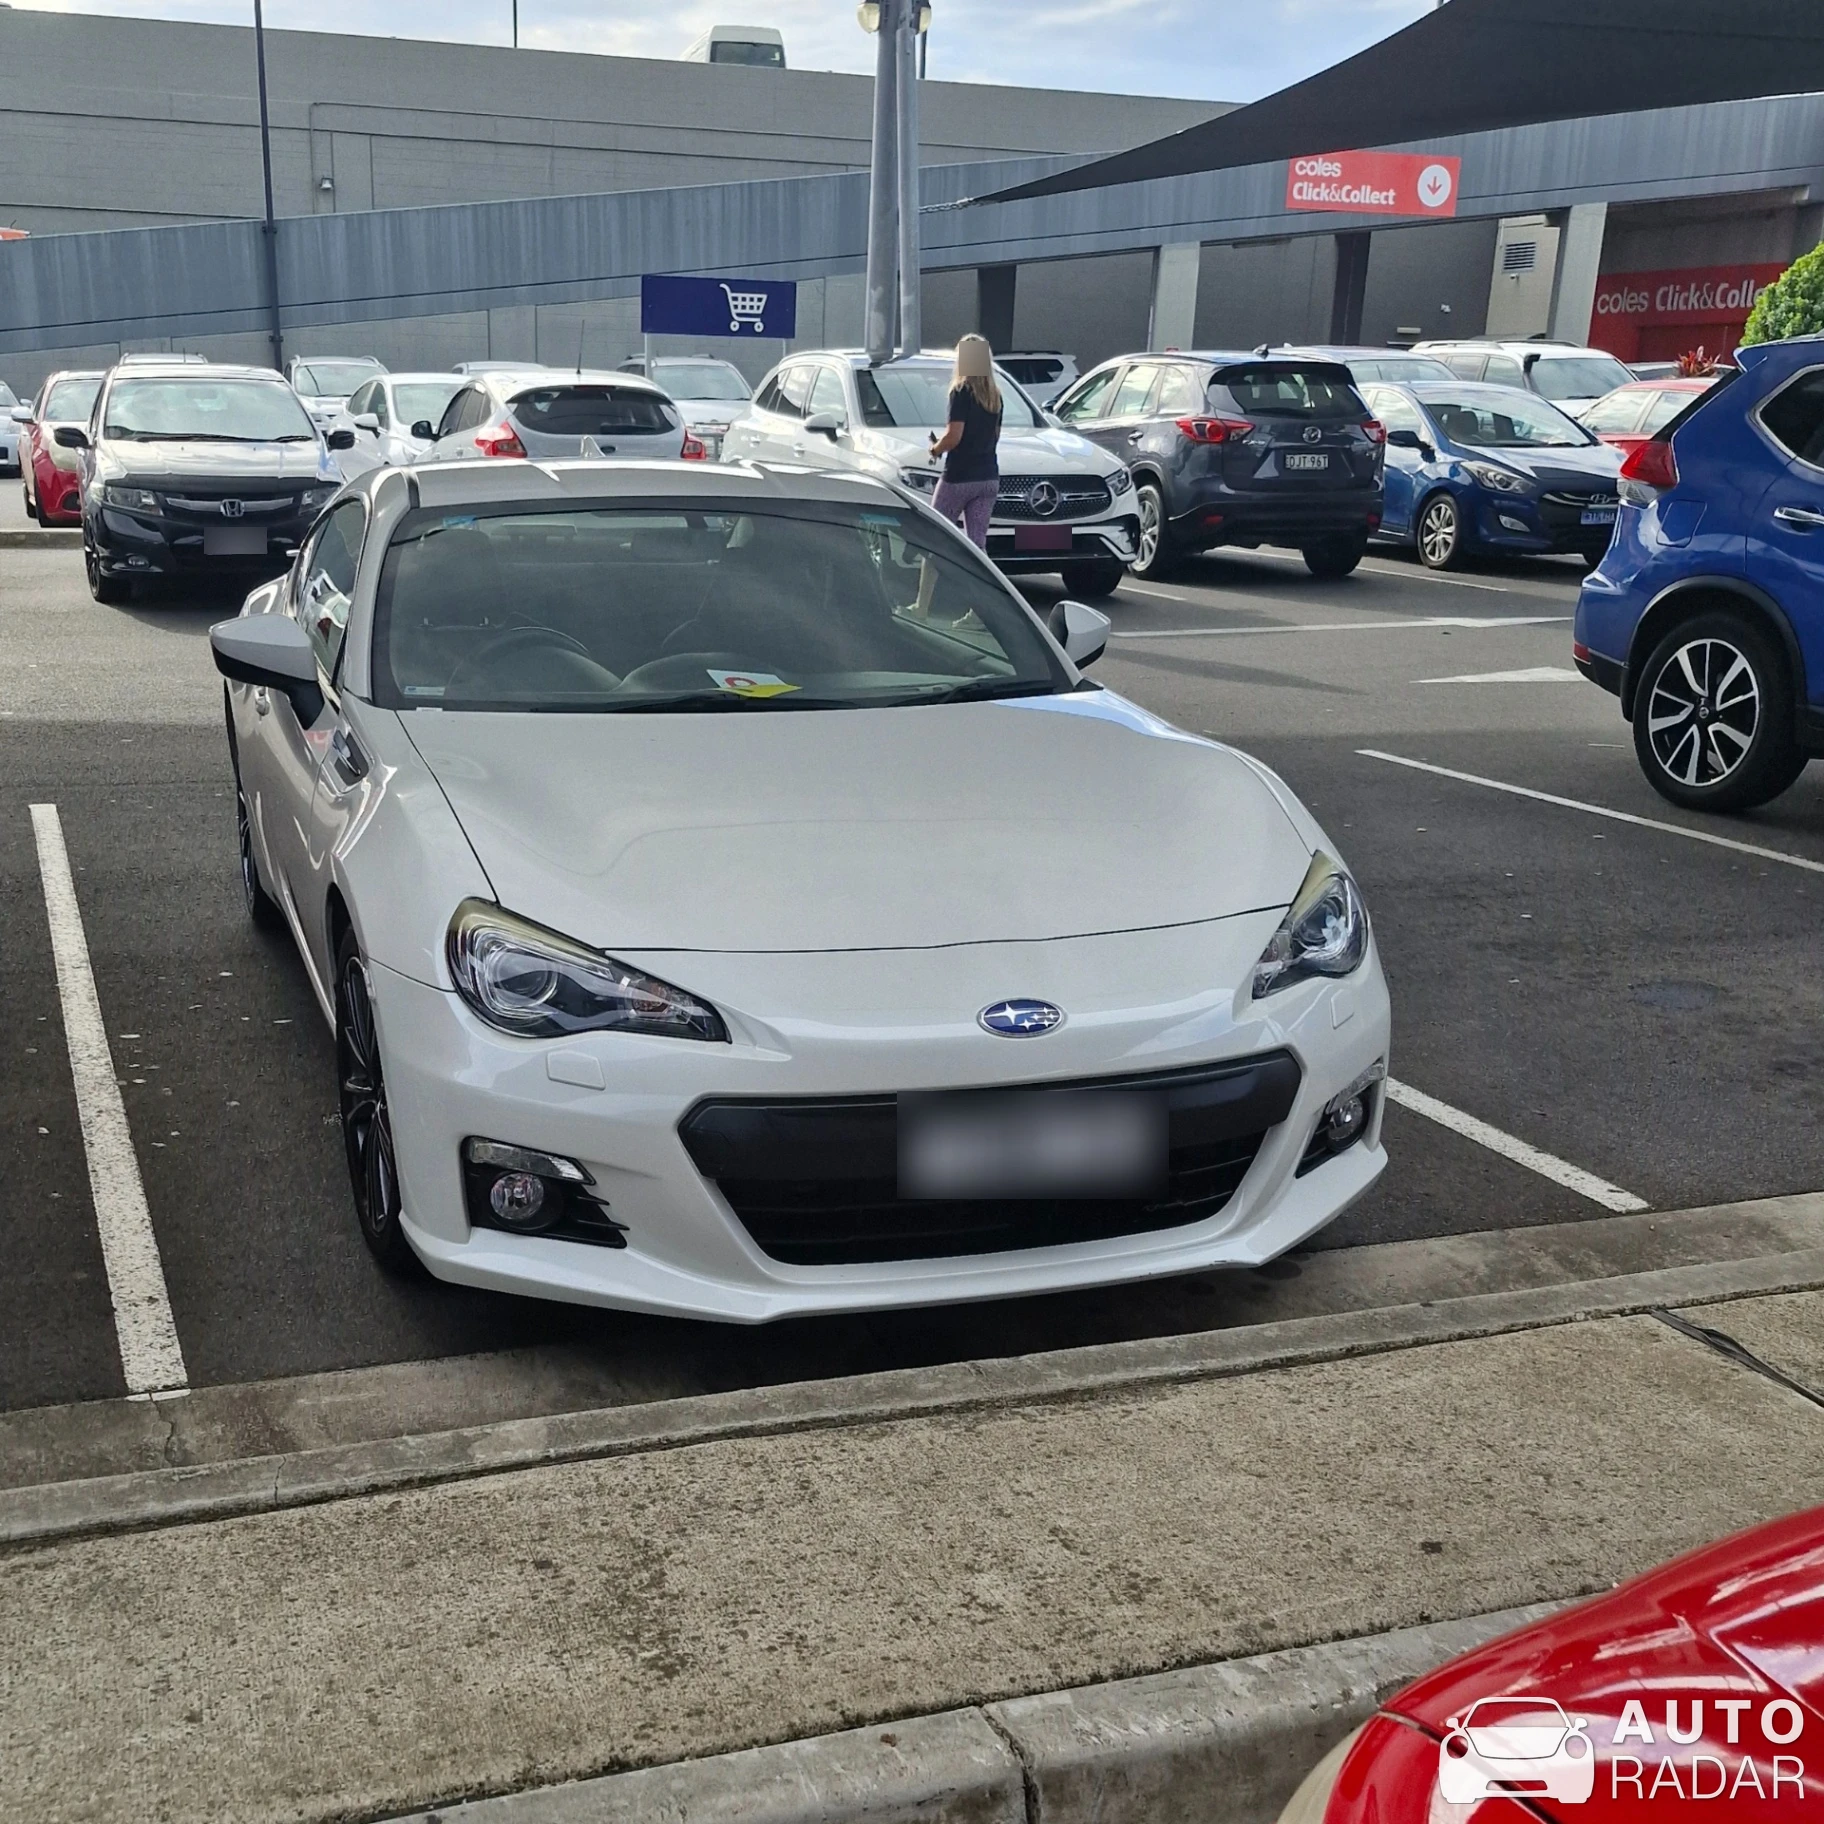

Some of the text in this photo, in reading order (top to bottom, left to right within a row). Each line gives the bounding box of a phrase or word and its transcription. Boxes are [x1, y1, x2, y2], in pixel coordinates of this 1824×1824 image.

[1294, 158, 1342, 178] coles
[1292, 181, 1396, 206] Click&Collect
[1596, 286, 1649, 314] coles
